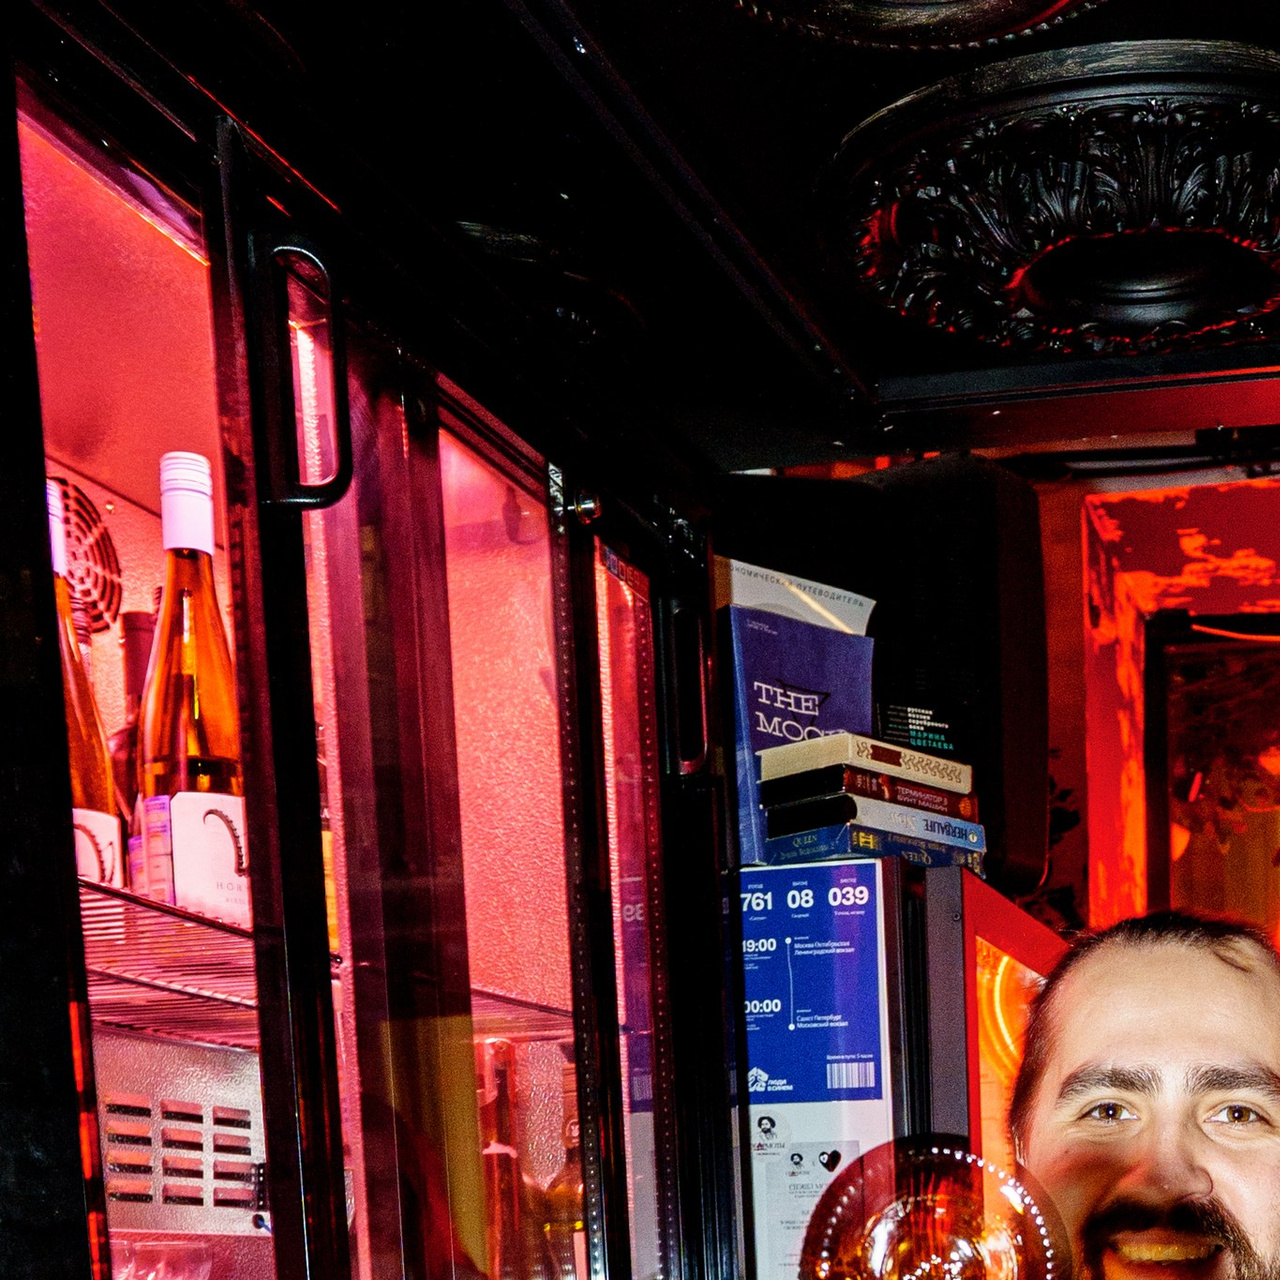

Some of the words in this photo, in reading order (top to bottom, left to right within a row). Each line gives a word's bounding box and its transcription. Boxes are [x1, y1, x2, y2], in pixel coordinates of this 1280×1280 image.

[754, 681, 820, 715] THE
[921, 818, 968, 841] HERBALIFE
[740, 891, 773, 912] 761
[787, 889, 814, 909] 08
[828, 886, 869, 906] 039
[742, 938, 777, 953] 19:00
